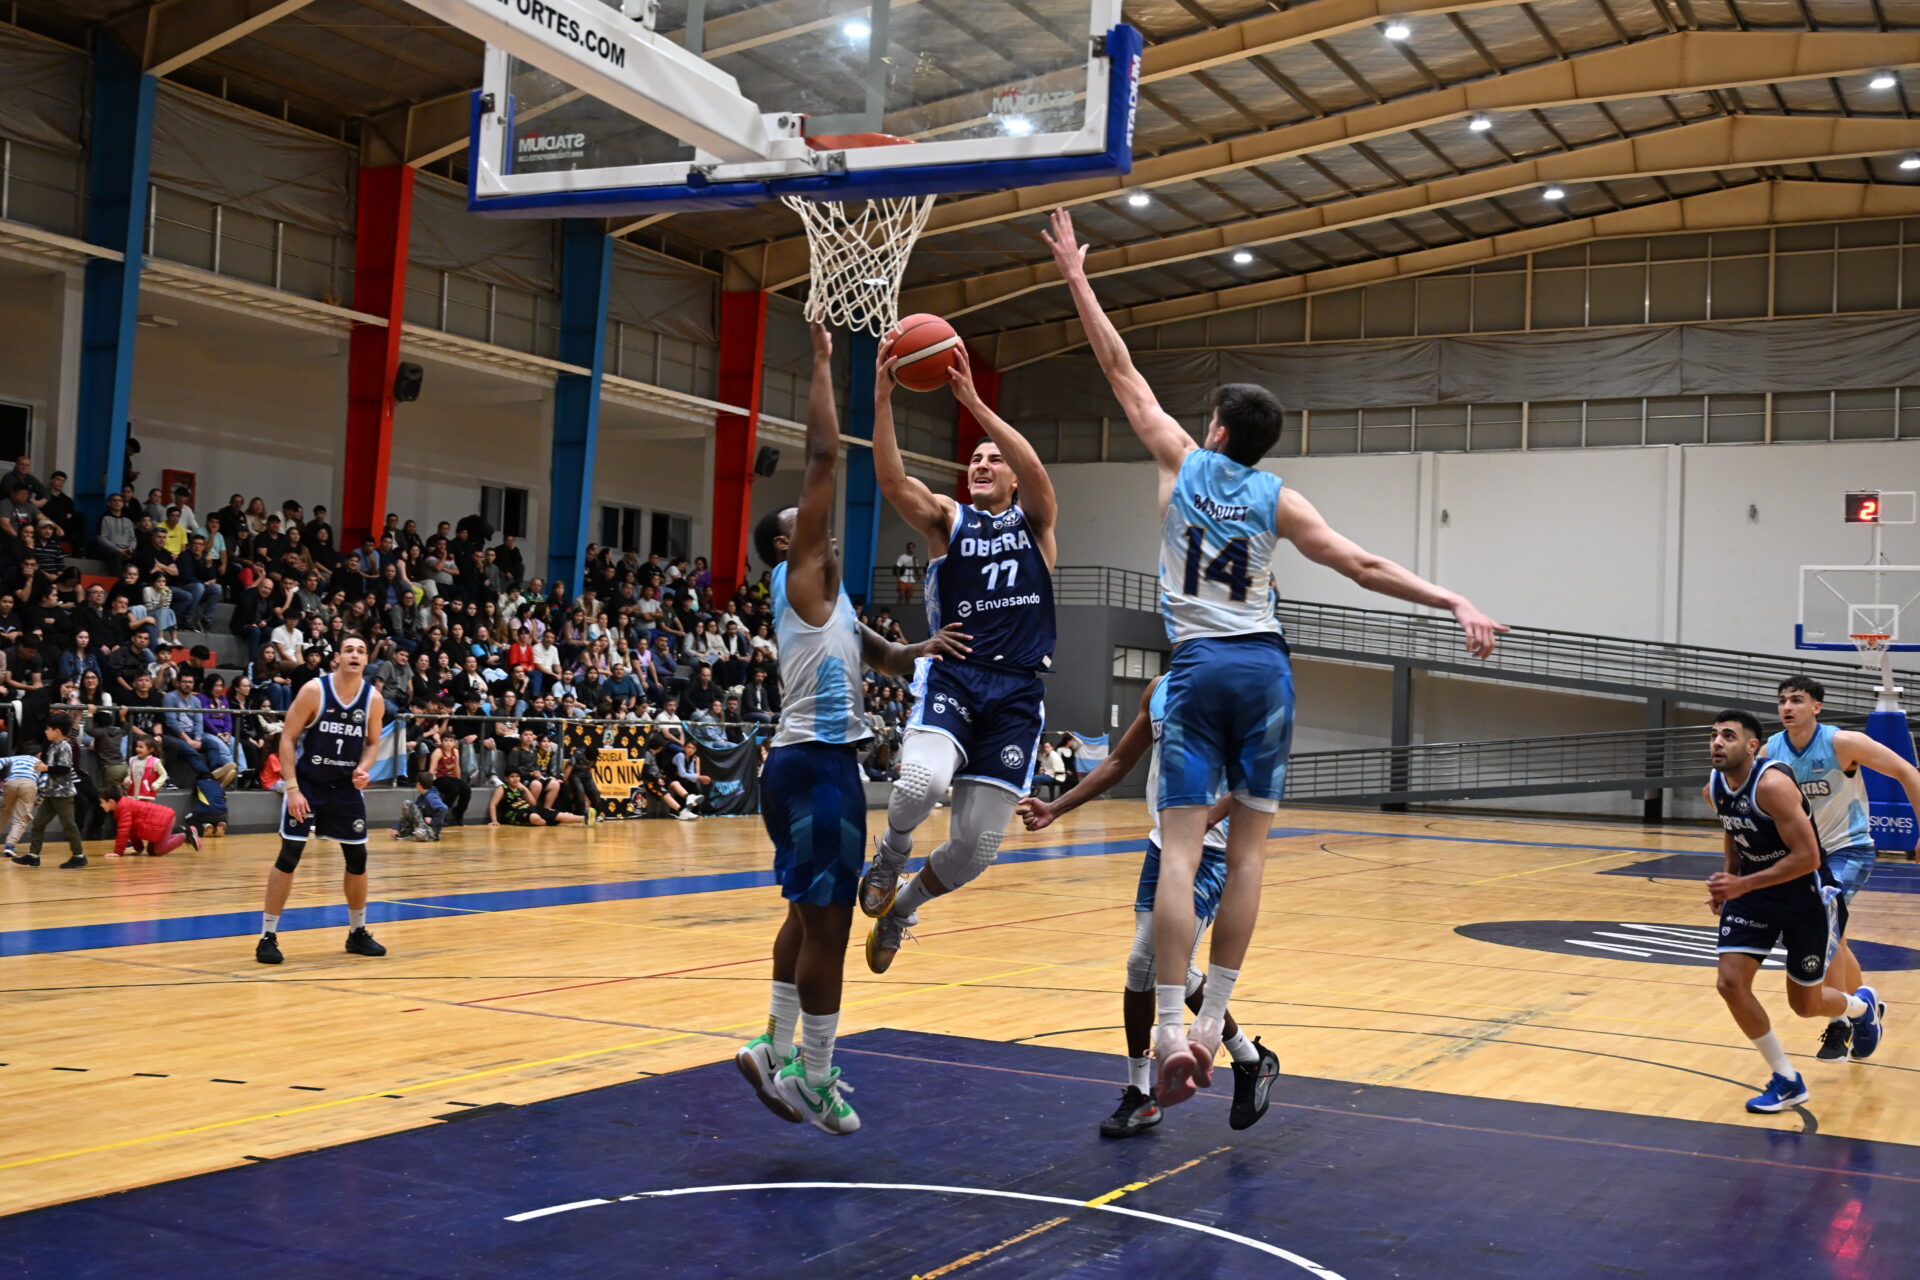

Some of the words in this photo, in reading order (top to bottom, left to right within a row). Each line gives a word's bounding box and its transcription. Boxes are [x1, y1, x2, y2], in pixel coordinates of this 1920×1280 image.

[496, 0, 626, 69] ORTES.COM
[1193, 493, 1249, 522] BASQUET
[1860, 501, 1876, 520] 2
[960, 529, 1032, 557] OBERA
[1182, 523, 1255, 603] 14
[975, 592, 1040, 612] Envasando
[319, 720, 363, 738] OBERA
